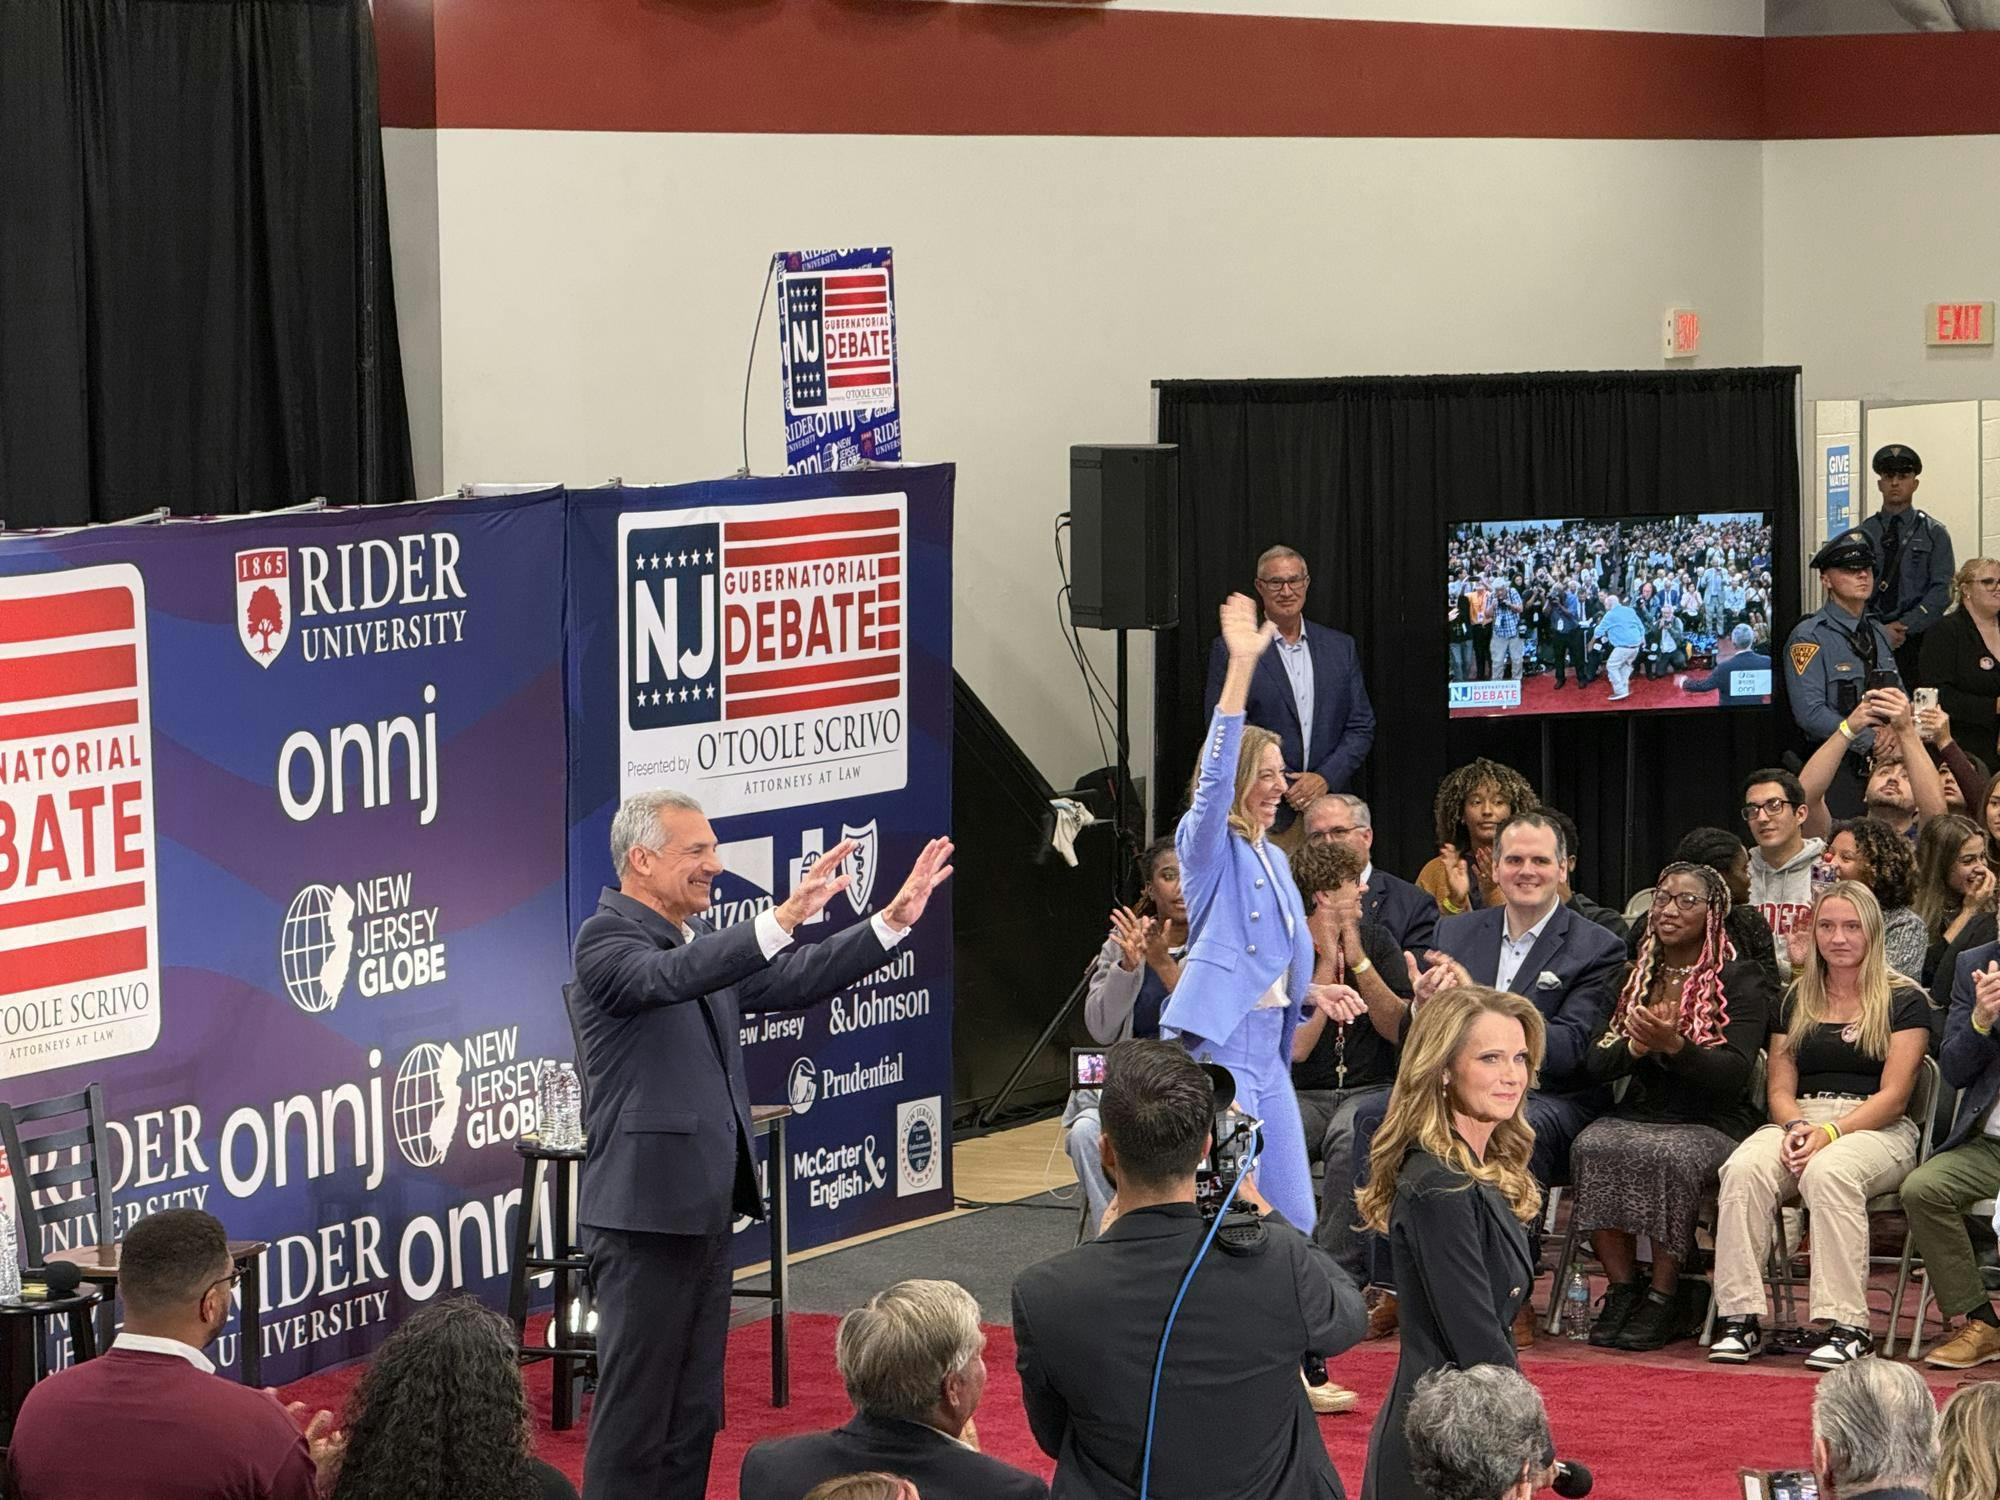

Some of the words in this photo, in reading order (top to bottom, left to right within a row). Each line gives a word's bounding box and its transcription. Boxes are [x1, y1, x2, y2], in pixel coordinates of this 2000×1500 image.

[792, 320, 819, 363] NJ
[824, 317, 888, 330] GUBERNATORIAL
[1936, 304, 1982, 341] EXIT
[825, 330, 890, 360] DEBATE
[785, 415, 815, 442] RIDER
[788, 434, 816, 452] NIVERSITY
[837, 436, 851, 449] NEW
[1829, 455, 1849, 473] GIVE
[1829, 474, 1848, 487] WATER
[241, 555, 284, 578] 1865
[299, 532, 467, 616] RIDER
[724, 559, 877, 595] GUBERNATORIAL
[301, 610, 467, 662] UNIVERSITY
[635, 574, 715, 684] NJ
[725, 590, 877, 666] DEBATE
[1450, 686, 1472, 701] NJ
[1474, 690, 1517, 701] DEBATE
[278, 684, 438, 825] onnj
[697, 722, 806, 771] O'TOOLE
[814, 708, 900, 755] SCRIVO
[628, 756, 676, 777] Presented
[678, 756, 691, 774] by
[744, 773, 812, 795] ATTORNEYS
[357, 872, 411, 916] NEW
[357, 907, 438, 957] JERSEY
[358, 944, 446, 997] GLOBE
[0, 998, 63, 1035] OOLE
[70, 982, 149, 1023] SCRIVO
[829, 987, 930, 1035] &Johnson
[9, 1038, 70, 1059] ATTORNEYS
[465, 1026, 517, 1070] NEW
[740, 1024, 759, 1046] ew
[761, 1015, 805, 1040] Jersey
[465, 1058, 544, 1112] JERSEY
[822, 1052, 904, 1100] Prudential
[220, 1049, 384, 1198] onnj
[794, 1144, 862, 1180] McCarter
[864, 1135, 887, 1192] &
[810, 1170, 862, 1209] English
[217, 1290, 389, 1367] UIVERSITY
